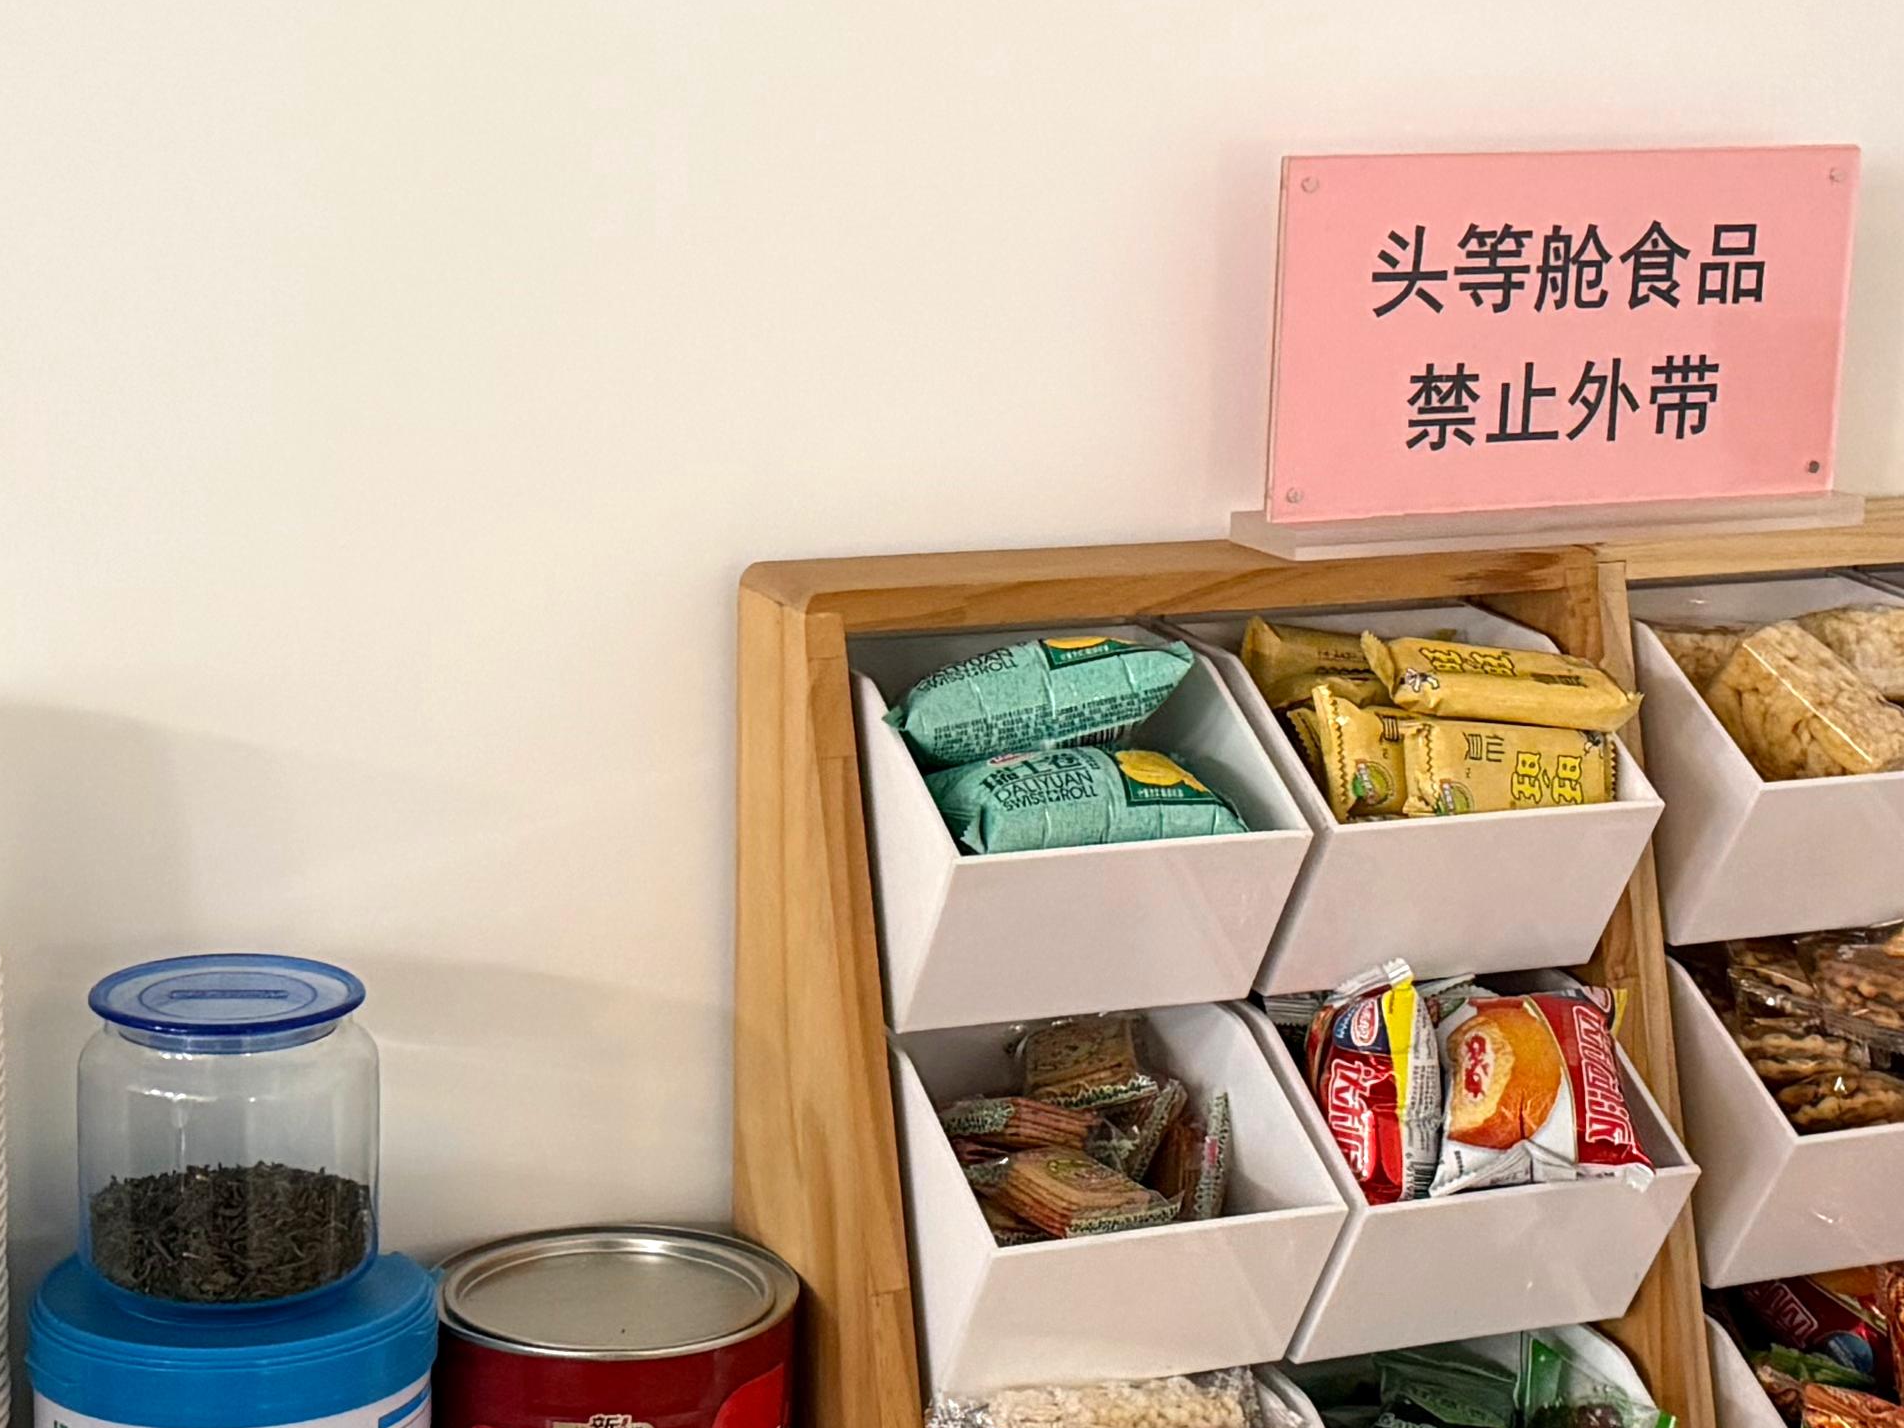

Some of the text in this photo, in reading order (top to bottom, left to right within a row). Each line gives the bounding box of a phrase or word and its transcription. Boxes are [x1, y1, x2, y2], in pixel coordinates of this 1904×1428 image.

[1371, 219, 1767, 318] 头等舱食品
[1405, 354, 1720, 452] 禁止外带
[993, 769, 1094, 803] DALIYUAN
[1059, 784, 1099, 802] ROLL
